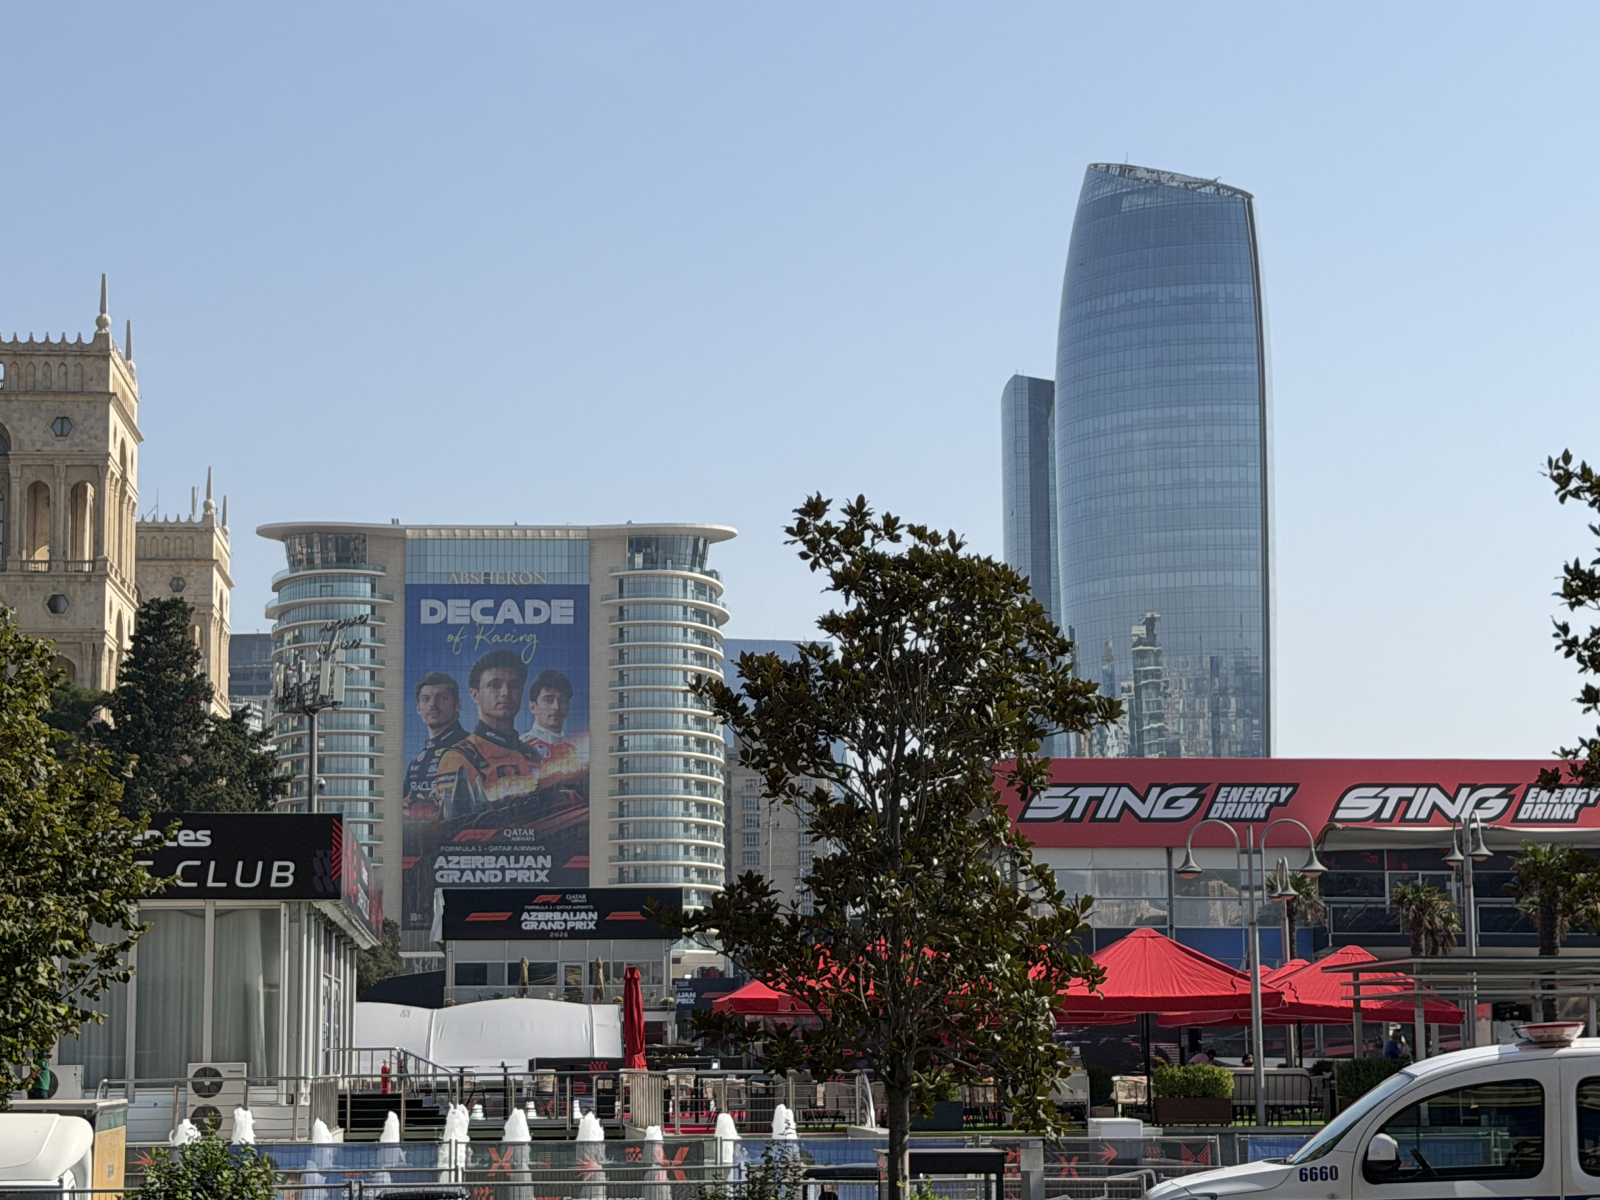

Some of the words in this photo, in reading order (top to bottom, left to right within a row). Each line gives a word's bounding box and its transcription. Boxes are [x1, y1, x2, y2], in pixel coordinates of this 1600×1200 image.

[448, 572, 548, 585] ABSHERON
[421, 599, 574, 624] DECADE
[447, 626, 467, 655] of
[474, 619, 540, 664] Racing
[1024, 787, 1199, 819] STING
[1214, 787, 1293, 802] ENERGY
[1208, 803, 1269, 818] DRINK
[1334, 787, 1509, 819] STING
[1524, 788, 1600, 803] ENERGY
[1517, 804, 1580, 819] DRINK
[504, 828, 535, 838] QATAR
[434, 855, 552, 869] AZERBAIJAN
[175, 860, 296, 888] CLUB
[435, 869, 502, 883] GRAND
[505, 869, 550, 883] PRIX
[565, 893, 586, 901] QATAR
[520, 911, 598, 920] AZERBAIJAN
[521, 920, 566, 930] GRAND
[567, 920, 597, 930] PRIX
[1298, 1165, 1339, 1182] 6660
